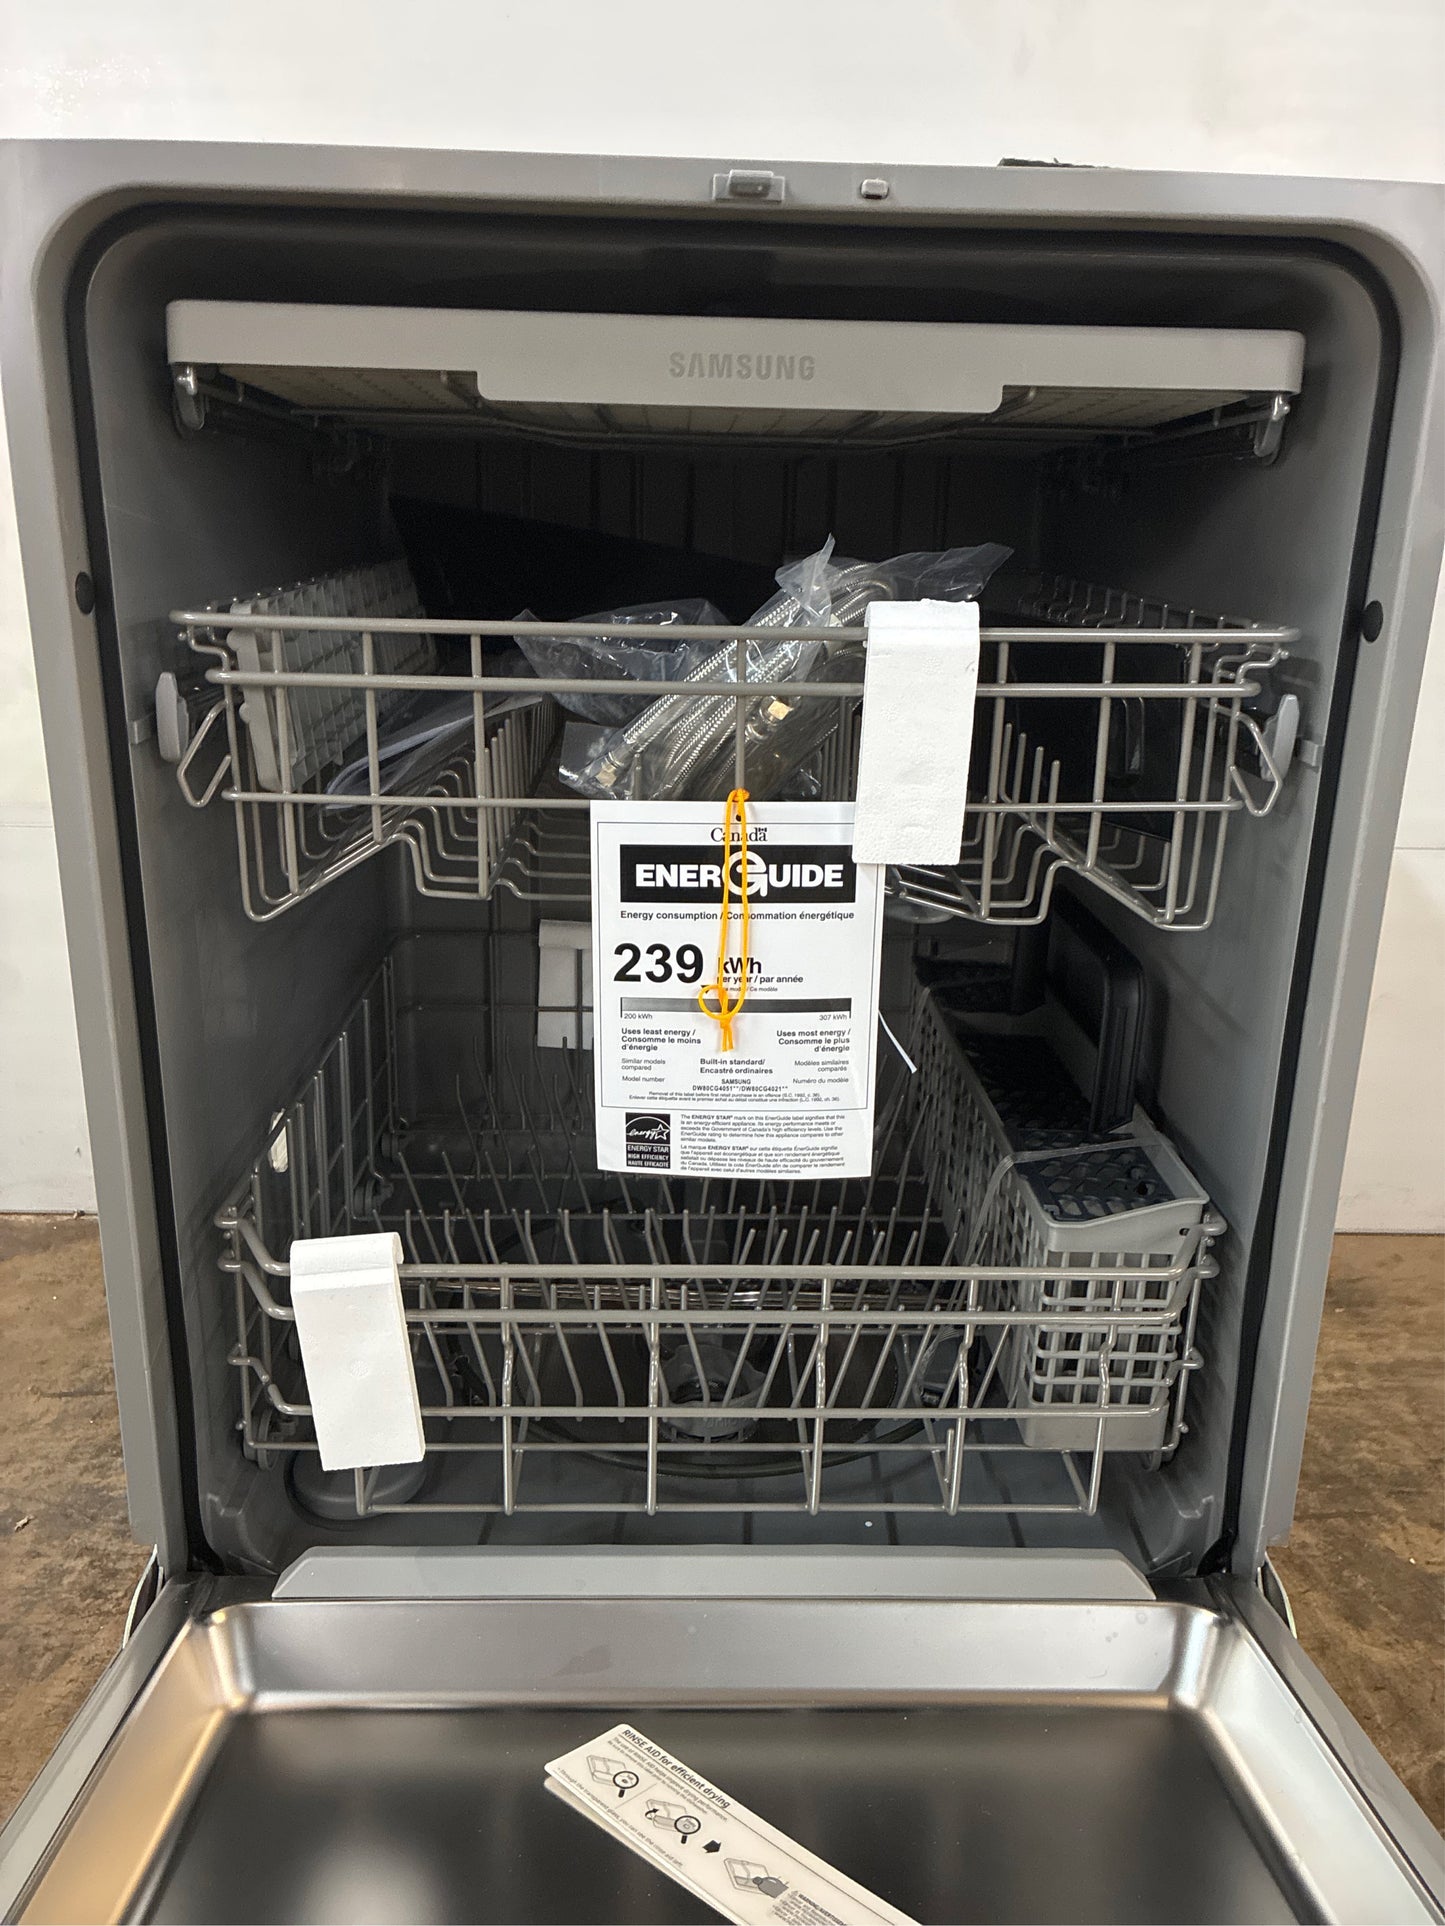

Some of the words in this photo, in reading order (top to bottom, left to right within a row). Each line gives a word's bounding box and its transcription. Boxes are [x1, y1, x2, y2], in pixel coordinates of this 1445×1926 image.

[669, 352, 815, 381] SAMSUNG
[620, 911, 653, 921] Energy
[656, 911, 718, 921] consumption
[726, 911, 797, 921] Conommation
[799, 910, 855, 921] énergétique
[614, 943, 704, 984] 239
[718, 957, 762, 974] kWh
[733, 976, 752, 984] yer
[760, 976, 774, 984] par
[776, 974, 804, 983] année
[832, 1013, 847, 1021] kWh
[664, 1029, 690, 1037] energy
[820, 1029, 846, 1037] energy
[834, 1037, 850, 1045] plus
[622, 1044, 658, 1052] d'énergie
[814, 1045, 850, 1053] d'énergie
[622, 1729, 648, 1748] RINSE
[644, 1744, 661, 1758] AID
[659, 1755, 673, 1767] for
[670, 1764, 705, 1789] efficient
[703, 1787, 731, 1809] drying
